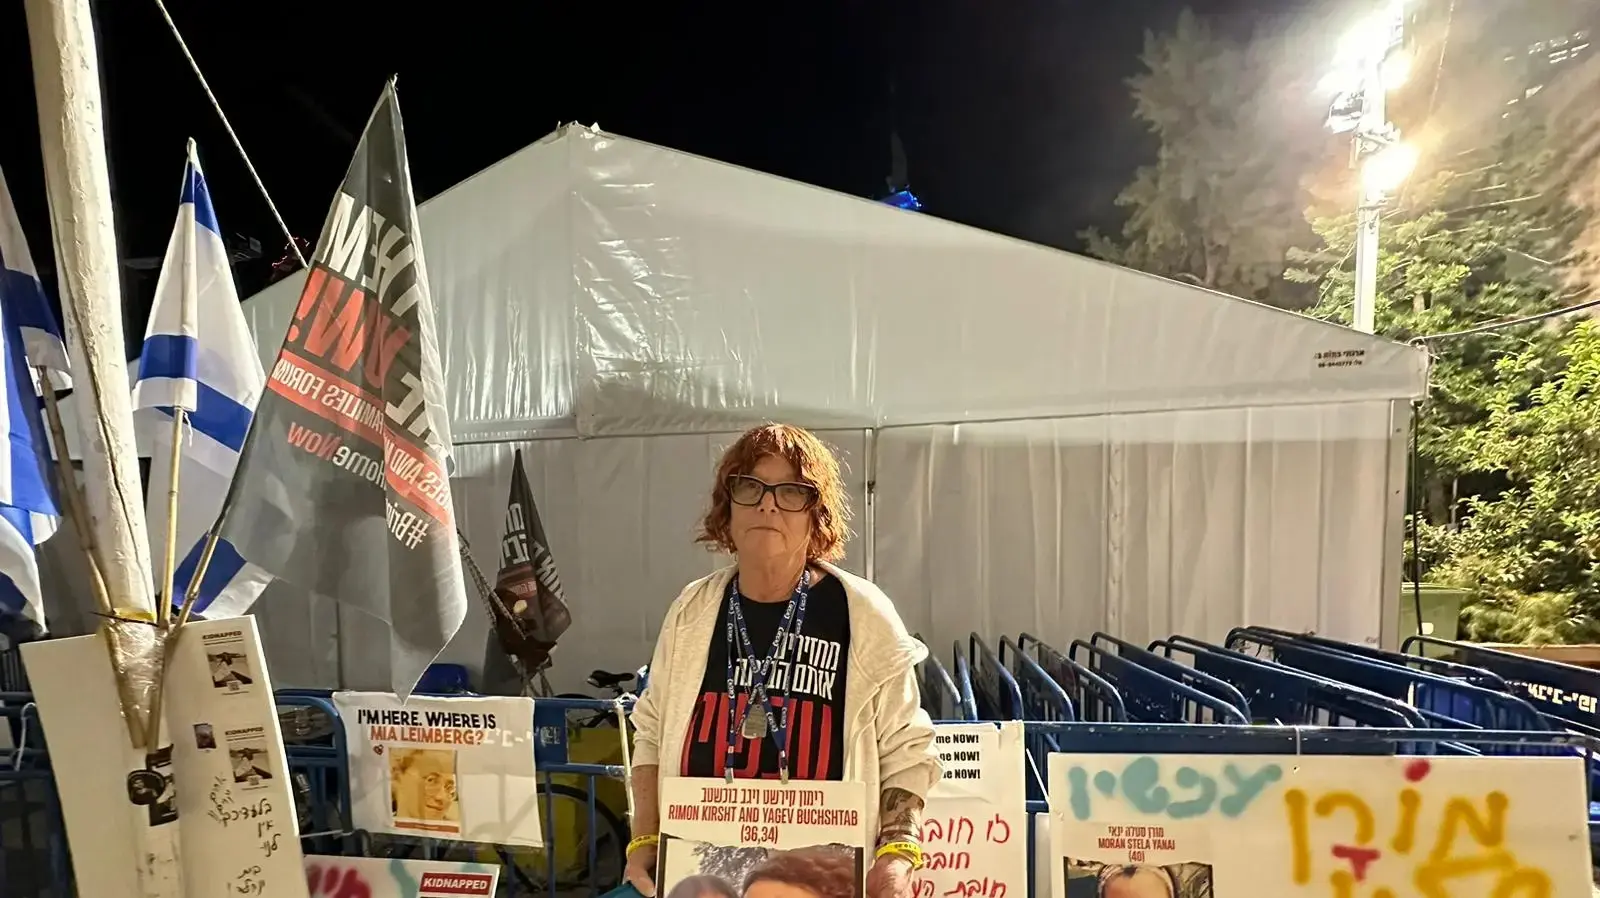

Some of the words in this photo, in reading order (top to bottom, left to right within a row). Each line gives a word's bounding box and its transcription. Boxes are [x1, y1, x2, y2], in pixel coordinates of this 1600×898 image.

[792, 663, 836, 700] אותם
[358, 709, 379, 725] I'M
[382, 710, 423, 727] HERE.
[428, 711, 481, 728] WHERE
[484, 713, 497, 730] IS
[370, 725, 398, 742] MIA
[400, 726, 484, 746] LEIMBERG?
[936, 735, 951, 744] me
[953, 734, 979, 744] NOW!
[954, 752, 980, 761] NOW!
[955, 769, 981, 779] NOW!
[701, 787, 738, 804] בוכשטב
[740, 788, 760, 805] ויגב
[763, 789, 797, 808] קירשט
[799, 790, 825, 807] רימון
[668, 804, 699, 821] RIMON
[701, 805, 737, 822] KIRSHT
[738, 806, 759, 823] AND
[762, 807, 794, 824] YAGEV
[796, 808, 858, 826] BUCHSHTAB
[740, 826, 778, 844] (36,34)
[919, 816, 974, 845] חוב
[1125, 826, 1146, 838] סטלה
[1147, 827, 1164, 838] מורן
[1098, 838, 1126, 849] MORAN
[1127, 838, 1150, 850] STELA
[1152, 839, 1175, 850] YANAI
[1128, 850, 1145, 863] (40)
[424, 877, 487, 890] KIDNAPPED
